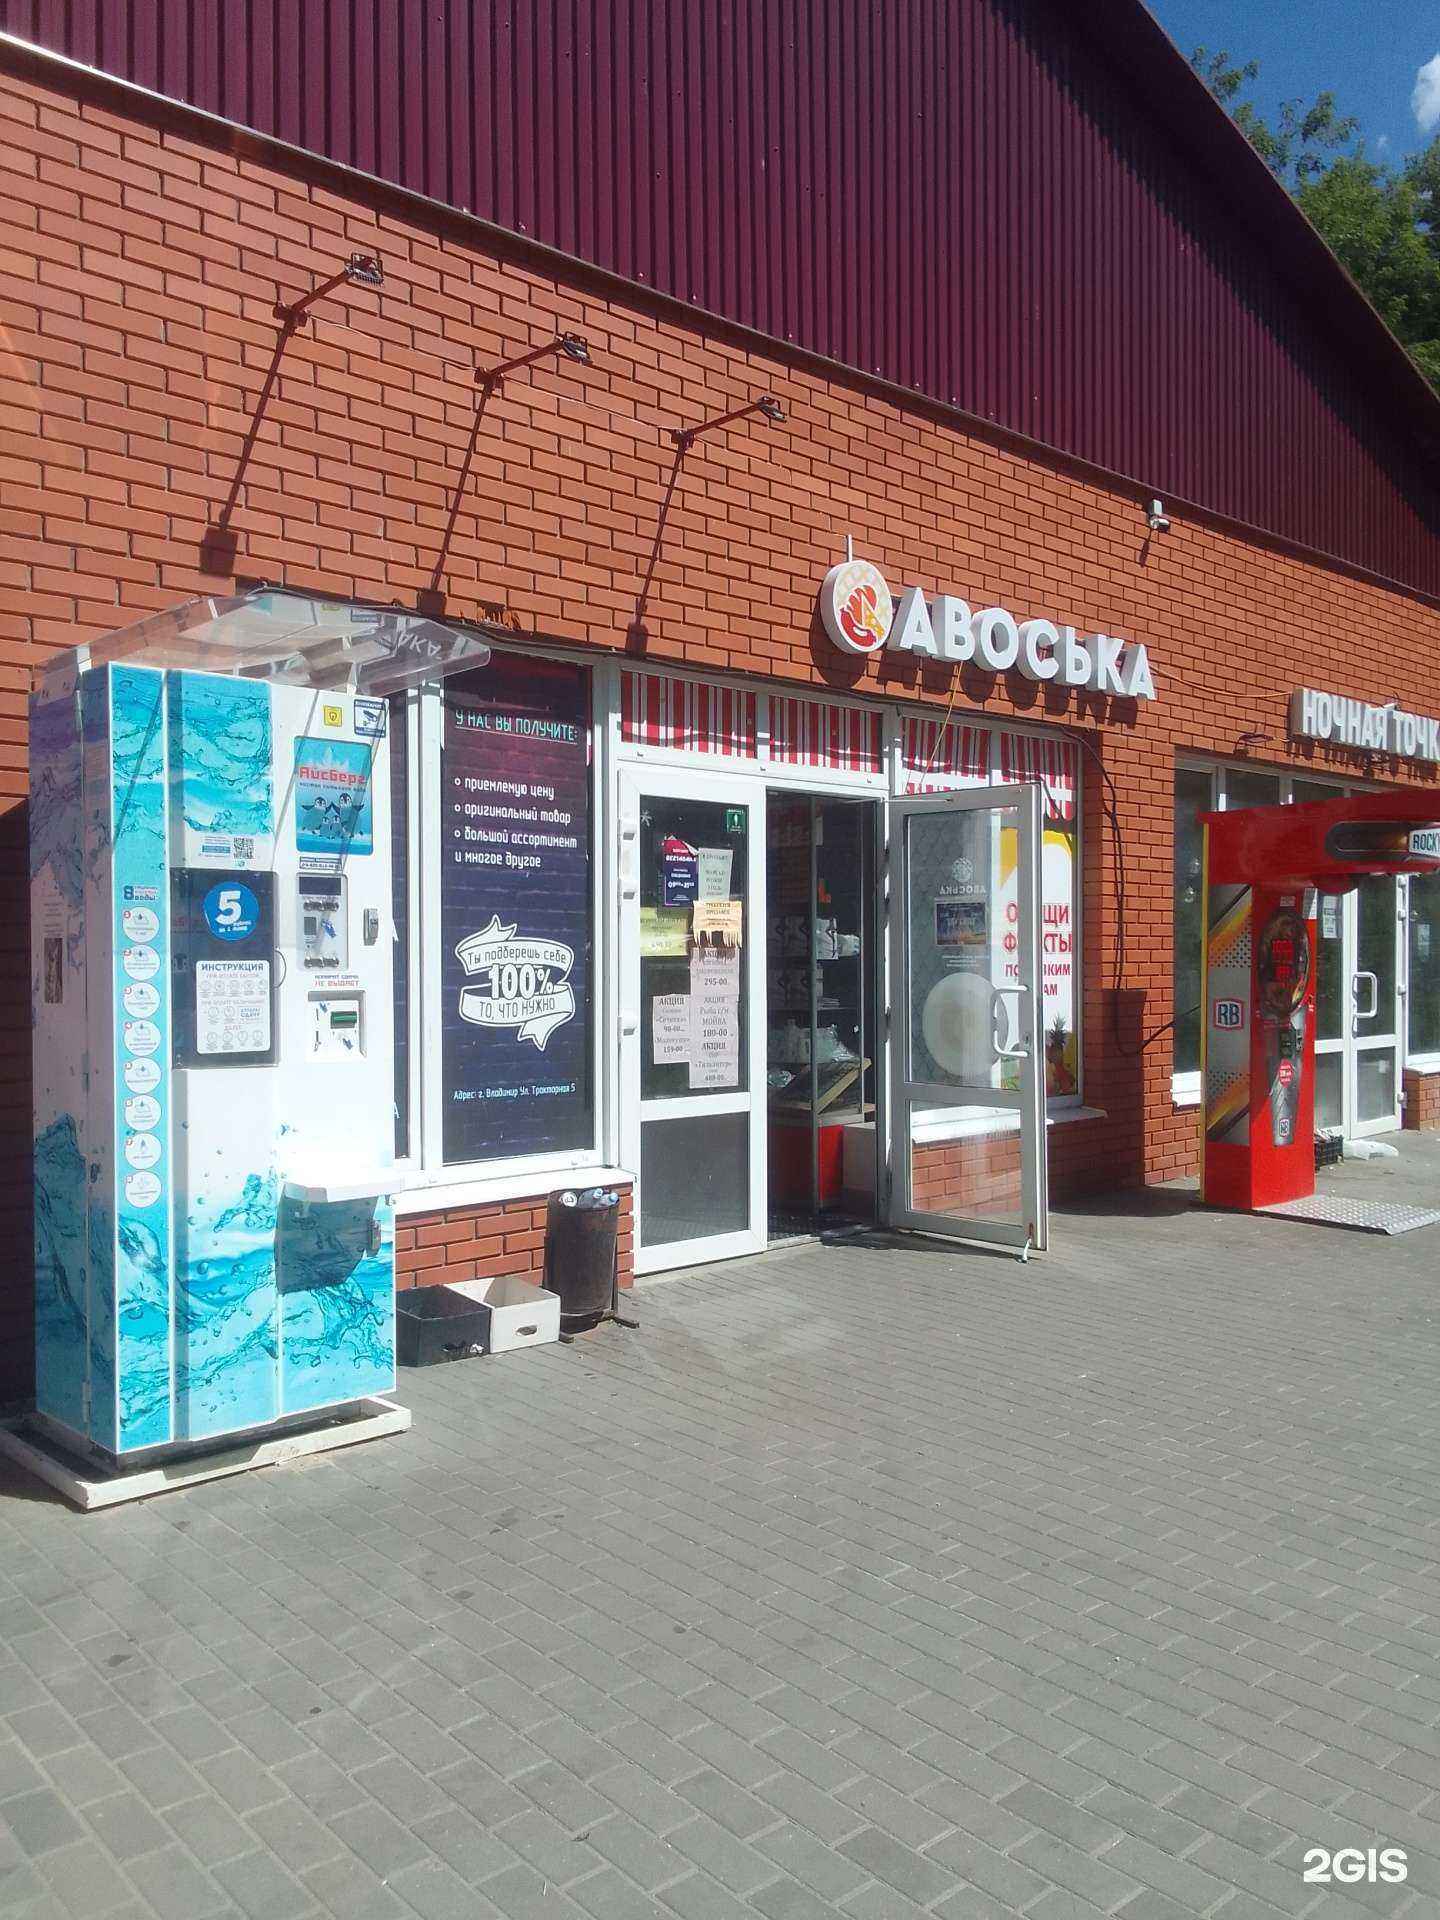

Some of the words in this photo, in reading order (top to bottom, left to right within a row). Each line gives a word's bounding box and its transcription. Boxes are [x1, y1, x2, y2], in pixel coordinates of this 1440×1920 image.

[887, 586, 1156, 700] АВОСЬКА
[455, 709, 464, 725] У
[468, 711, 491, 729] НАС
[496, 716, 512, 732] ВЫ
[515, 718, 579, 741] ПОЛУЧИТЕ:
[1303, 687, 1388, 750] НОЧНАЯ
[299, 766, 368, 786] Айсберг
[464, 777, 528, 798] приемлемую
[530, 784, 556, 801] цену
[464, 803, 538, 819] оригинальный
[540, 808, 571, 826] товар
[464, 825, 509, 844] большой
[511, 834, 578, 851] ассортимент
[455, 851, 462, 863] и
[464, 852, 503, 865] многое
[505, 851, 541, 869] другое
[215, 890, 242, 926] 5
[1006, 902, 1069, 928] ОЩИ
[1003, 931, 1073, 953] ФТЫ
[467, 951, 481, 965] Ты
[484, 945, 540, 963] подберешь
[543, 949, 567, 965] себе
[201, 963, 265, 972] ИНСТРУКЦИЯ
[488, 963, 554, 1000] 100%
[704, 976, 728, 987] 295-00
[480, 1001, 495, 1020] ТО,
[498, 1002, 518, 1019] ЧТО
[521, 998, 555, 1016] НУЖНО
[659, 997, 685, 1007] АКЦИЯ
[1217, 1003, 1240, 1026] RB
[703, 1028, 728, 1038] 180-00
[486, 1087, 519, 1099] Владимир
[531, 1083, 570, 1097] Тракторная
[570, 1082, 577, 1093] 5
